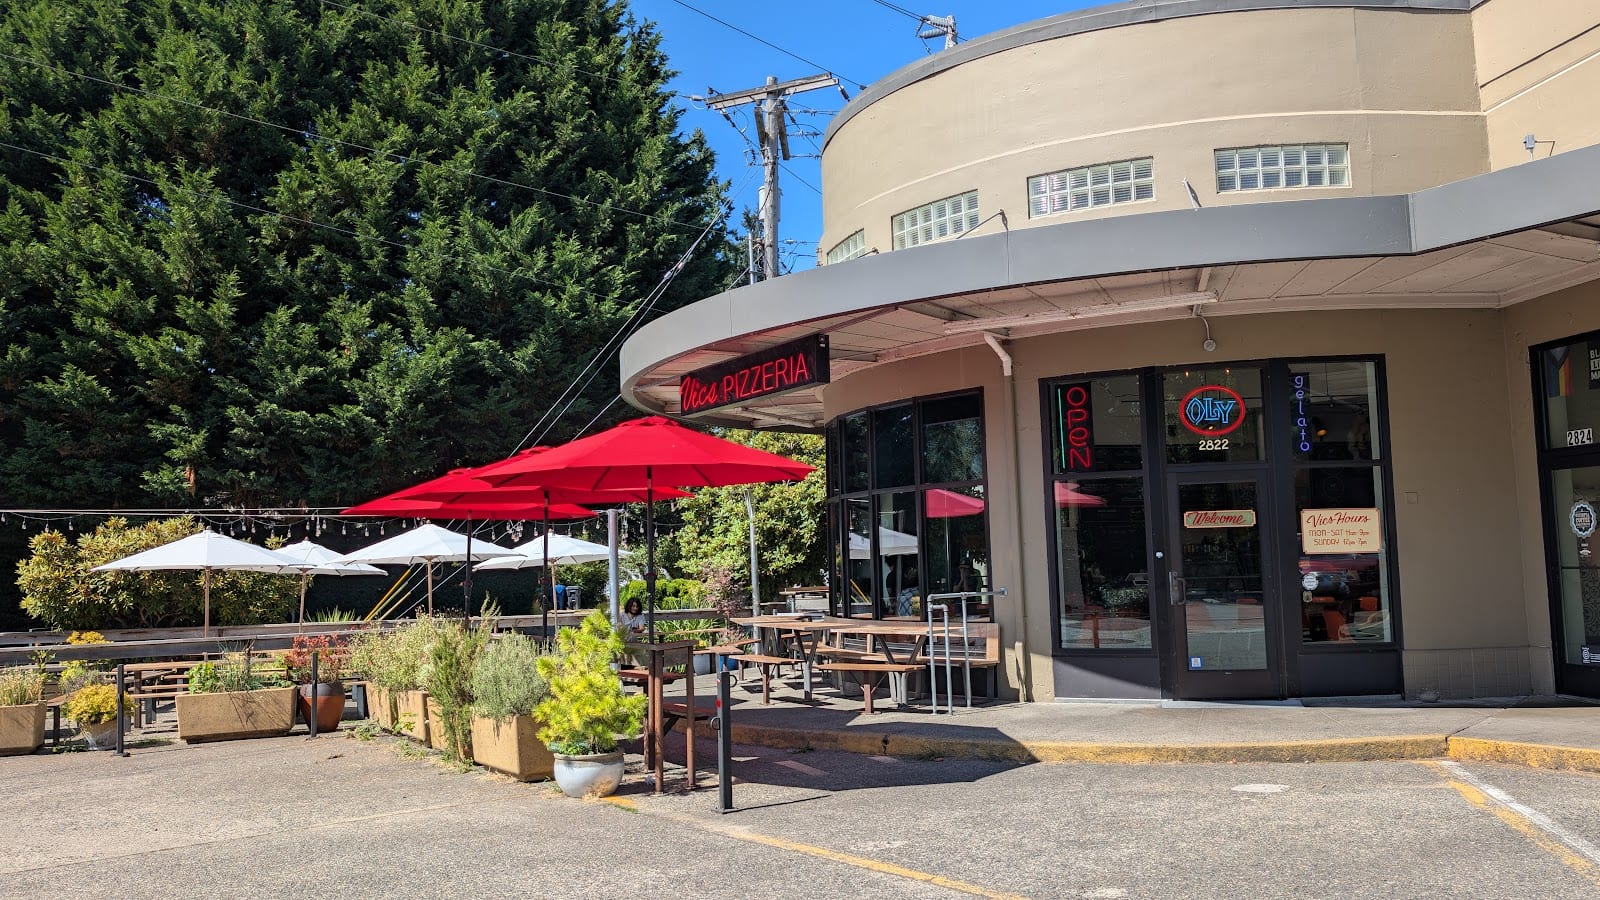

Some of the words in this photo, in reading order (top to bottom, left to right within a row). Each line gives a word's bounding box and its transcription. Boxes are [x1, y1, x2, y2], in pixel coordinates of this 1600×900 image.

[722, 352, 809, 401] PIZZERIA
[1185, 397, 1236, 425] OLY
[1295, 375, 1310, 451] gelato
[1198, 438, 1229, 451] 2822
[1568, 430, 1591, 445] 2824
[1187, 511, 1247, 525] Welcome
[1334, 512, 1370, 524] Hours
